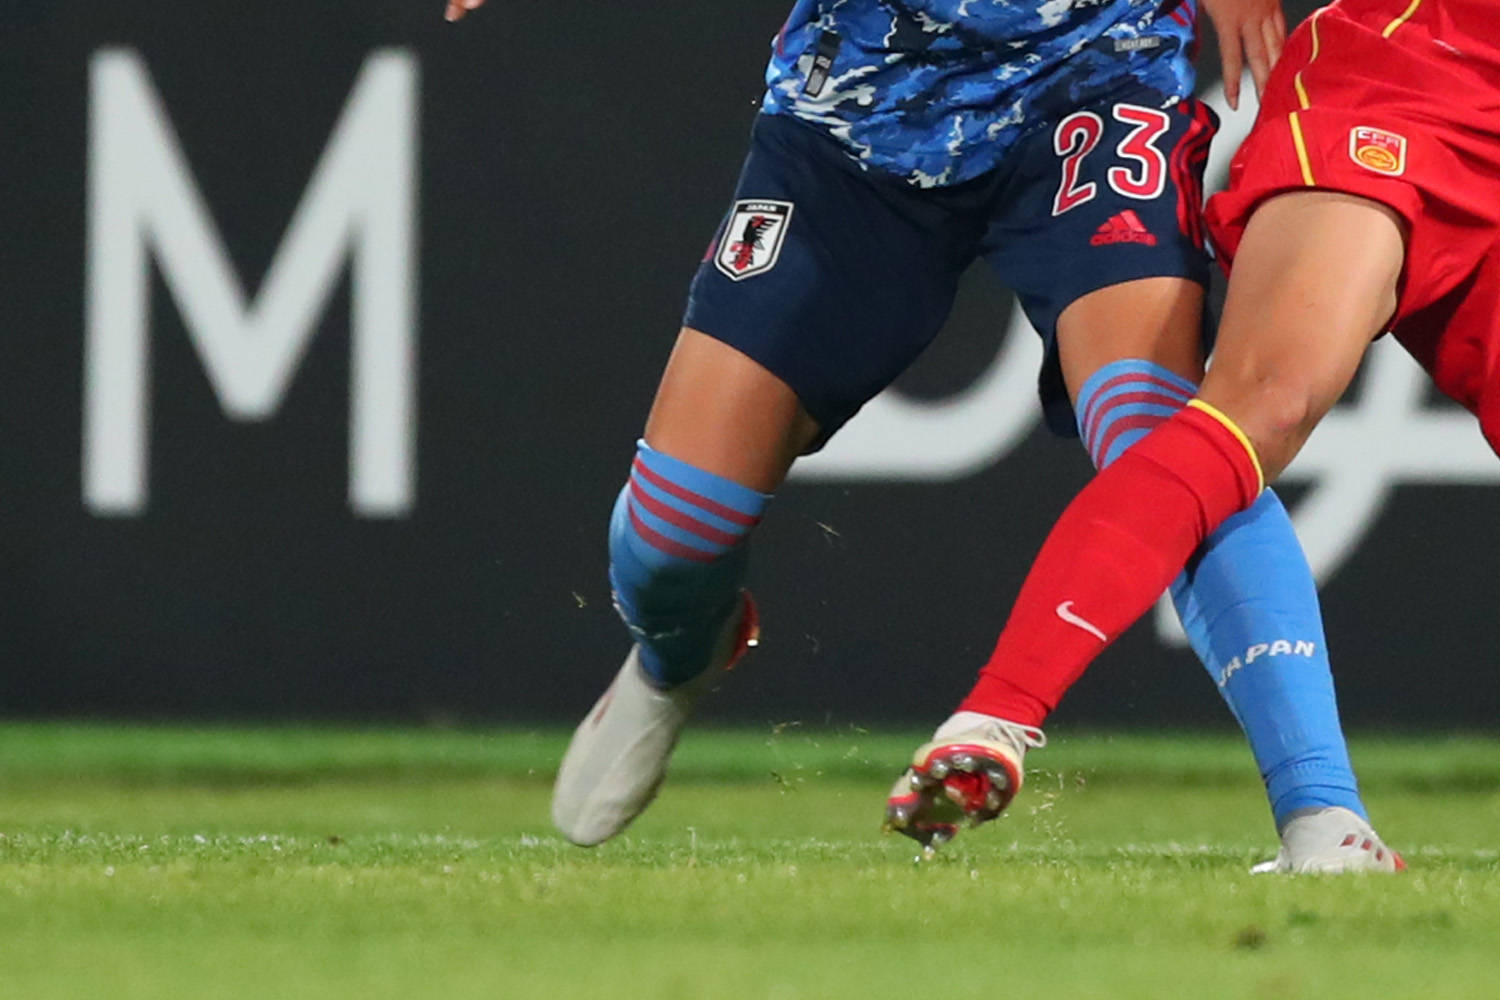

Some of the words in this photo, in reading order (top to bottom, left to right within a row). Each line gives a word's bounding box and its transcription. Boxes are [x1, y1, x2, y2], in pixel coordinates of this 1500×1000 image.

[1051, 103, 1169, 217] 23
[82, 44, 420, 517] M
[1218, 639, 1315, 687] JAPAN
